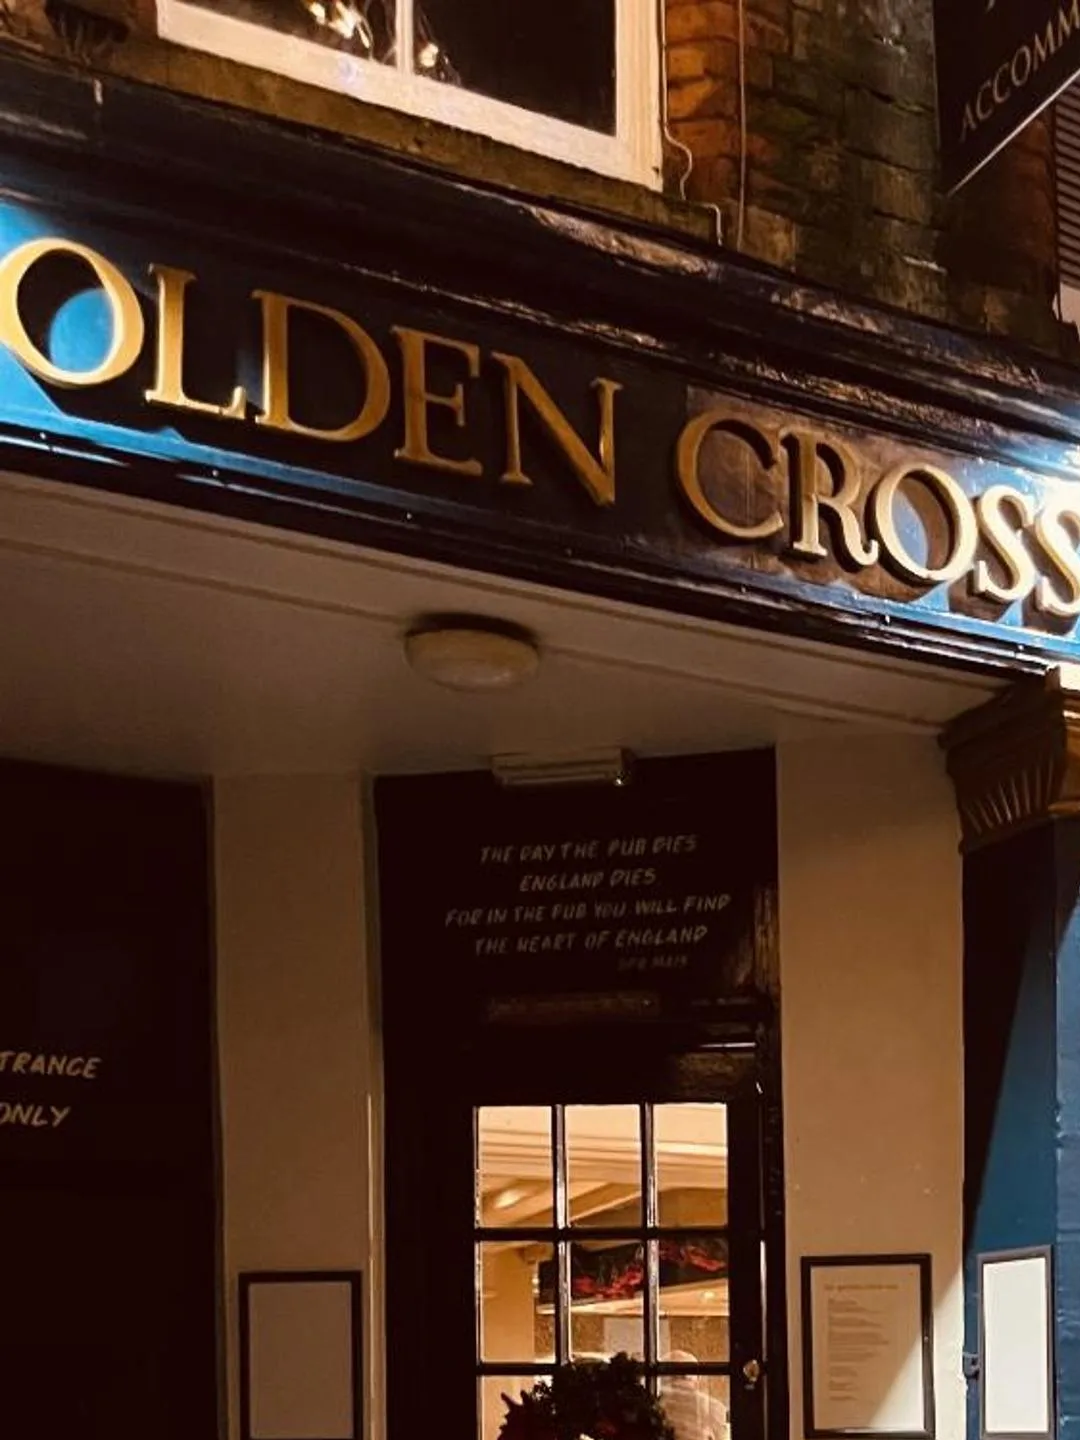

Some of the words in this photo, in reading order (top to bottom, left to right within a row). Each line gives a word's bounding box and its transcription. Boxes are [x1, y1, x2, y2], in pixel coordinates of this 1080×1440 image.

[0, 237, 622, 505] OLDEN
[480, 845, 514, 864] THE
[519, 844, 556, 861] DAY
[560, 840, 600, 860] THE
[607, 838, 647, 857] PUB
[652, 834, 698, 855] DIES
[519, 872, 604, 893] ENGLAND
[610, 868, 657, 888] DIES
[445, 908, 485, 928] FOR
[486, 907, 507, 925] IN
[514, 905, 547, 923] THE
[552, 902, 588, 920] PUB
[594, 901, 627, 920] YOU
[635, 899, 678, 916] WILL
[683, 893, 732, 915] FIND
[475, 937, 509, 957] THE
[517, 932, 577, 953] HEART
[584, 930, 612, 949] OF
[615, 924, 708, 949] ENGLAND
